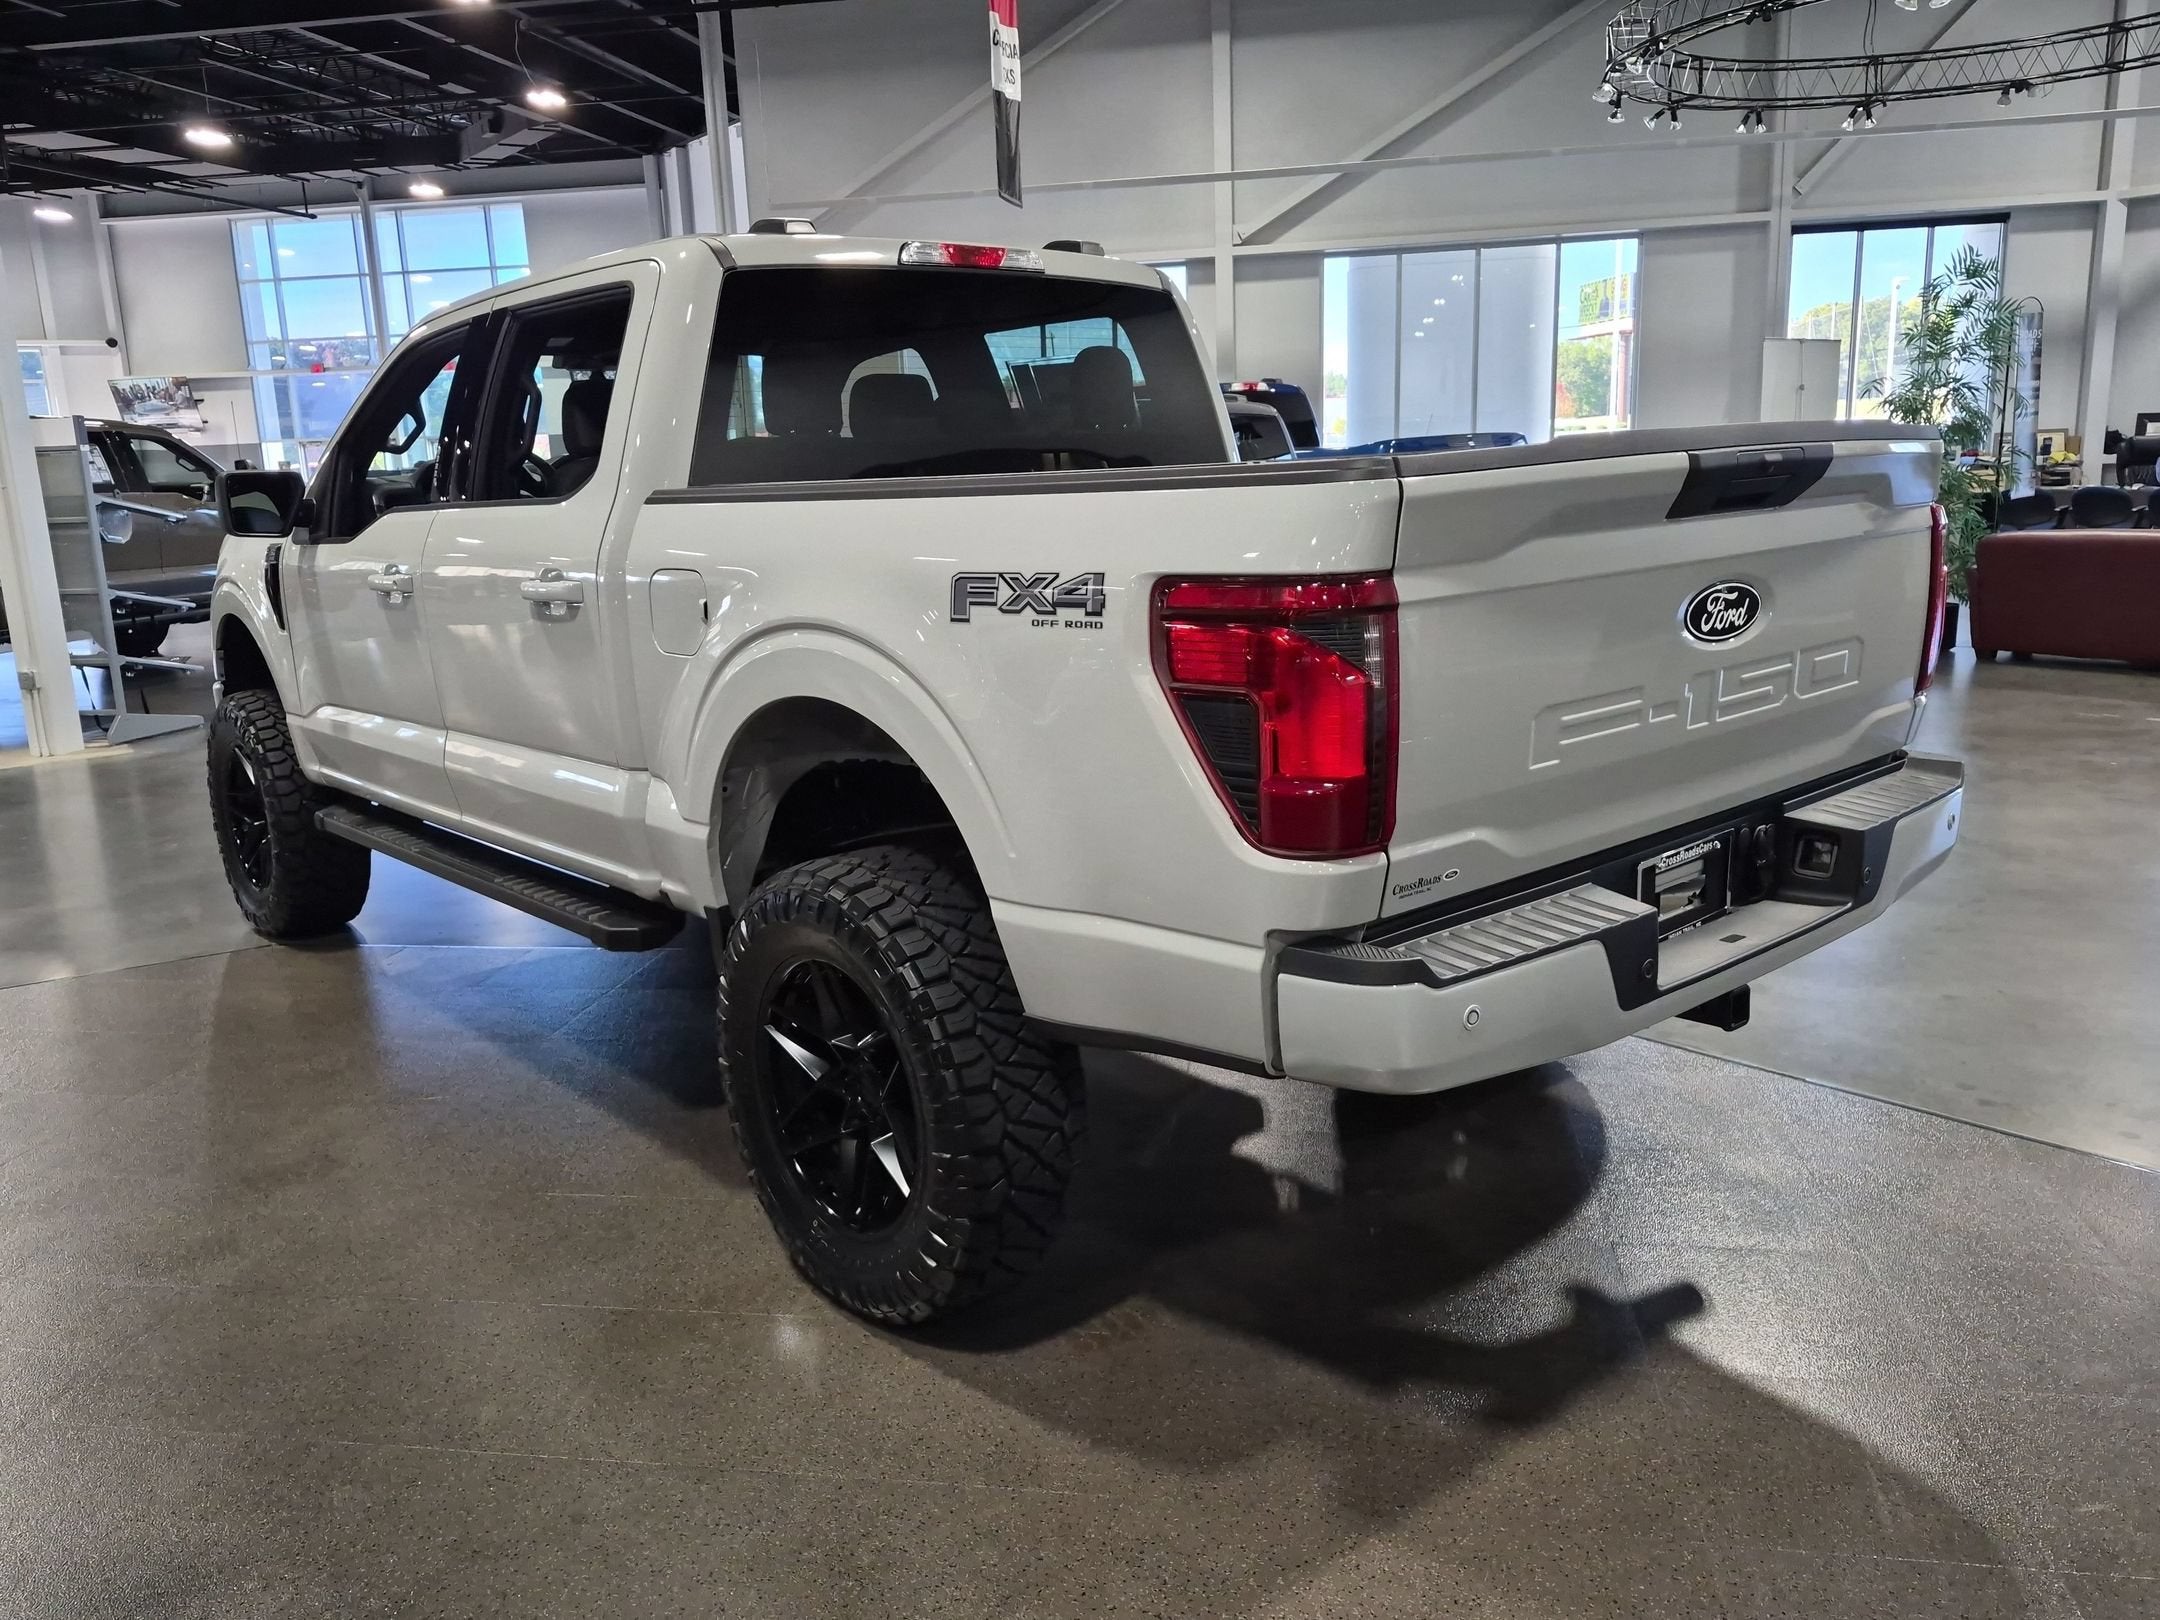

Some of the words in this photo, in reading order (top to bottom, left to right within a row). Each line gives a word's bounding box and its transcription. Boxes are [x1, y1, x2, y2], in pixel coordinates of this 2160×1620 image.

[950, 572, 1105, 623] FX4
[1701, 590, 1749, 632] Ford
[1031, 619, 1059, 628] OFF
[1064, 620, 1103, 630] ROAD
[1529, 635, 1865, 770] F-150
